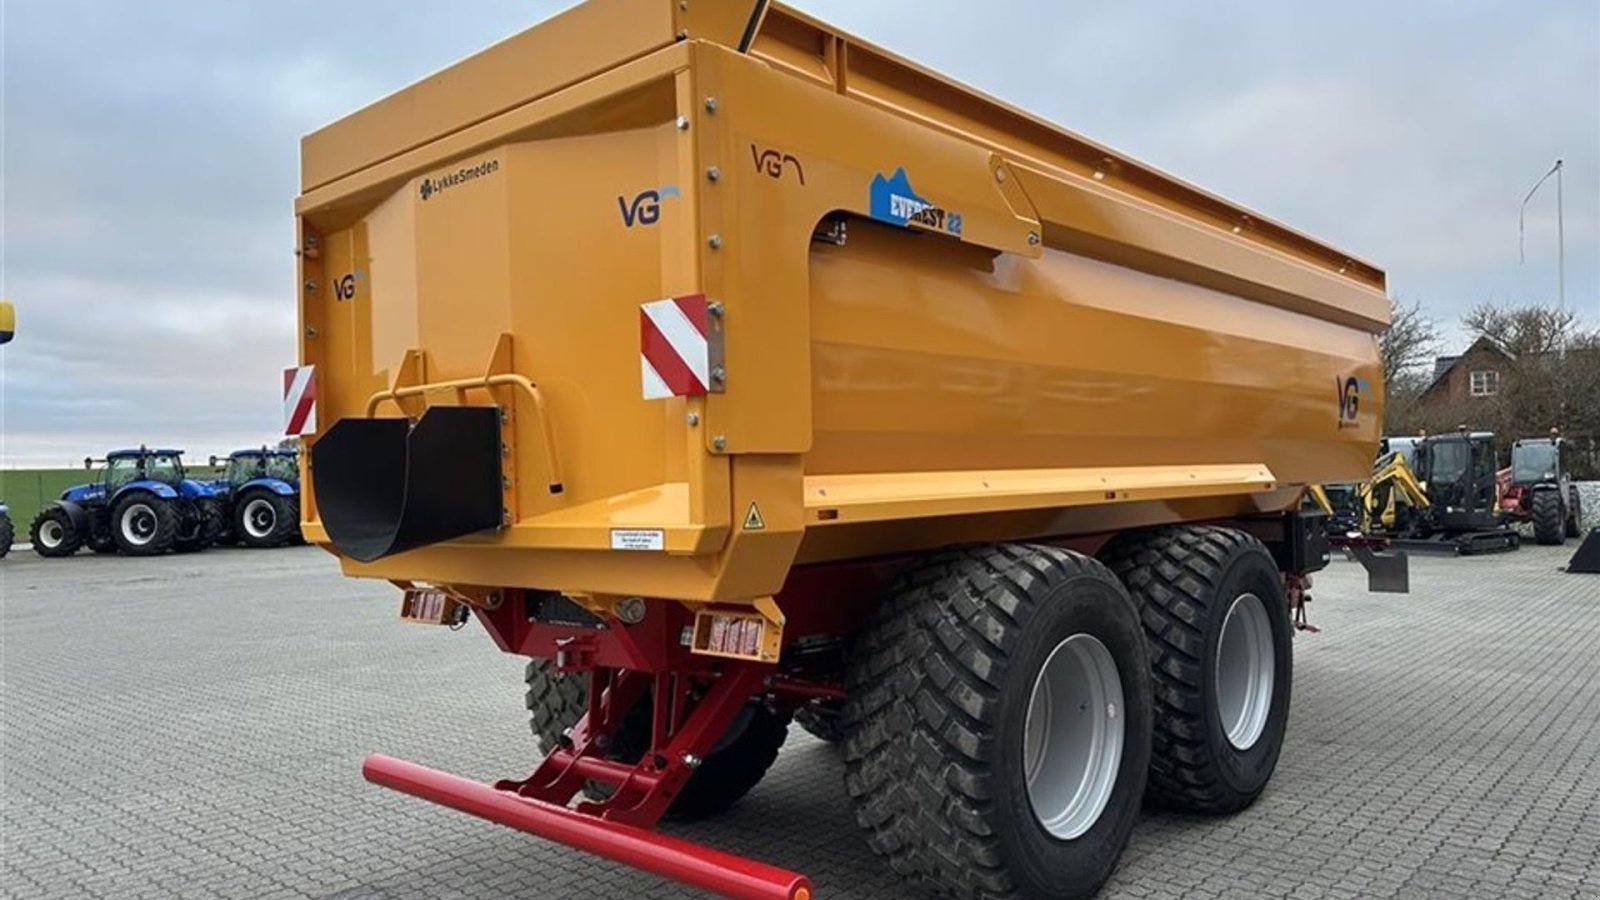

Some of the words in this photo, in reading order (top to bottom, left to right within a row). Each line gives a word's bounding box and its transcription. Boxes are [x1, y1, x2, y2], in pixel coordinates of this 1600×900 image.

[433, 160, 499, 193] LykkeSmeden
[890, 193, 945, 229] EVEREST
[947, 211, 962, 234] 22
